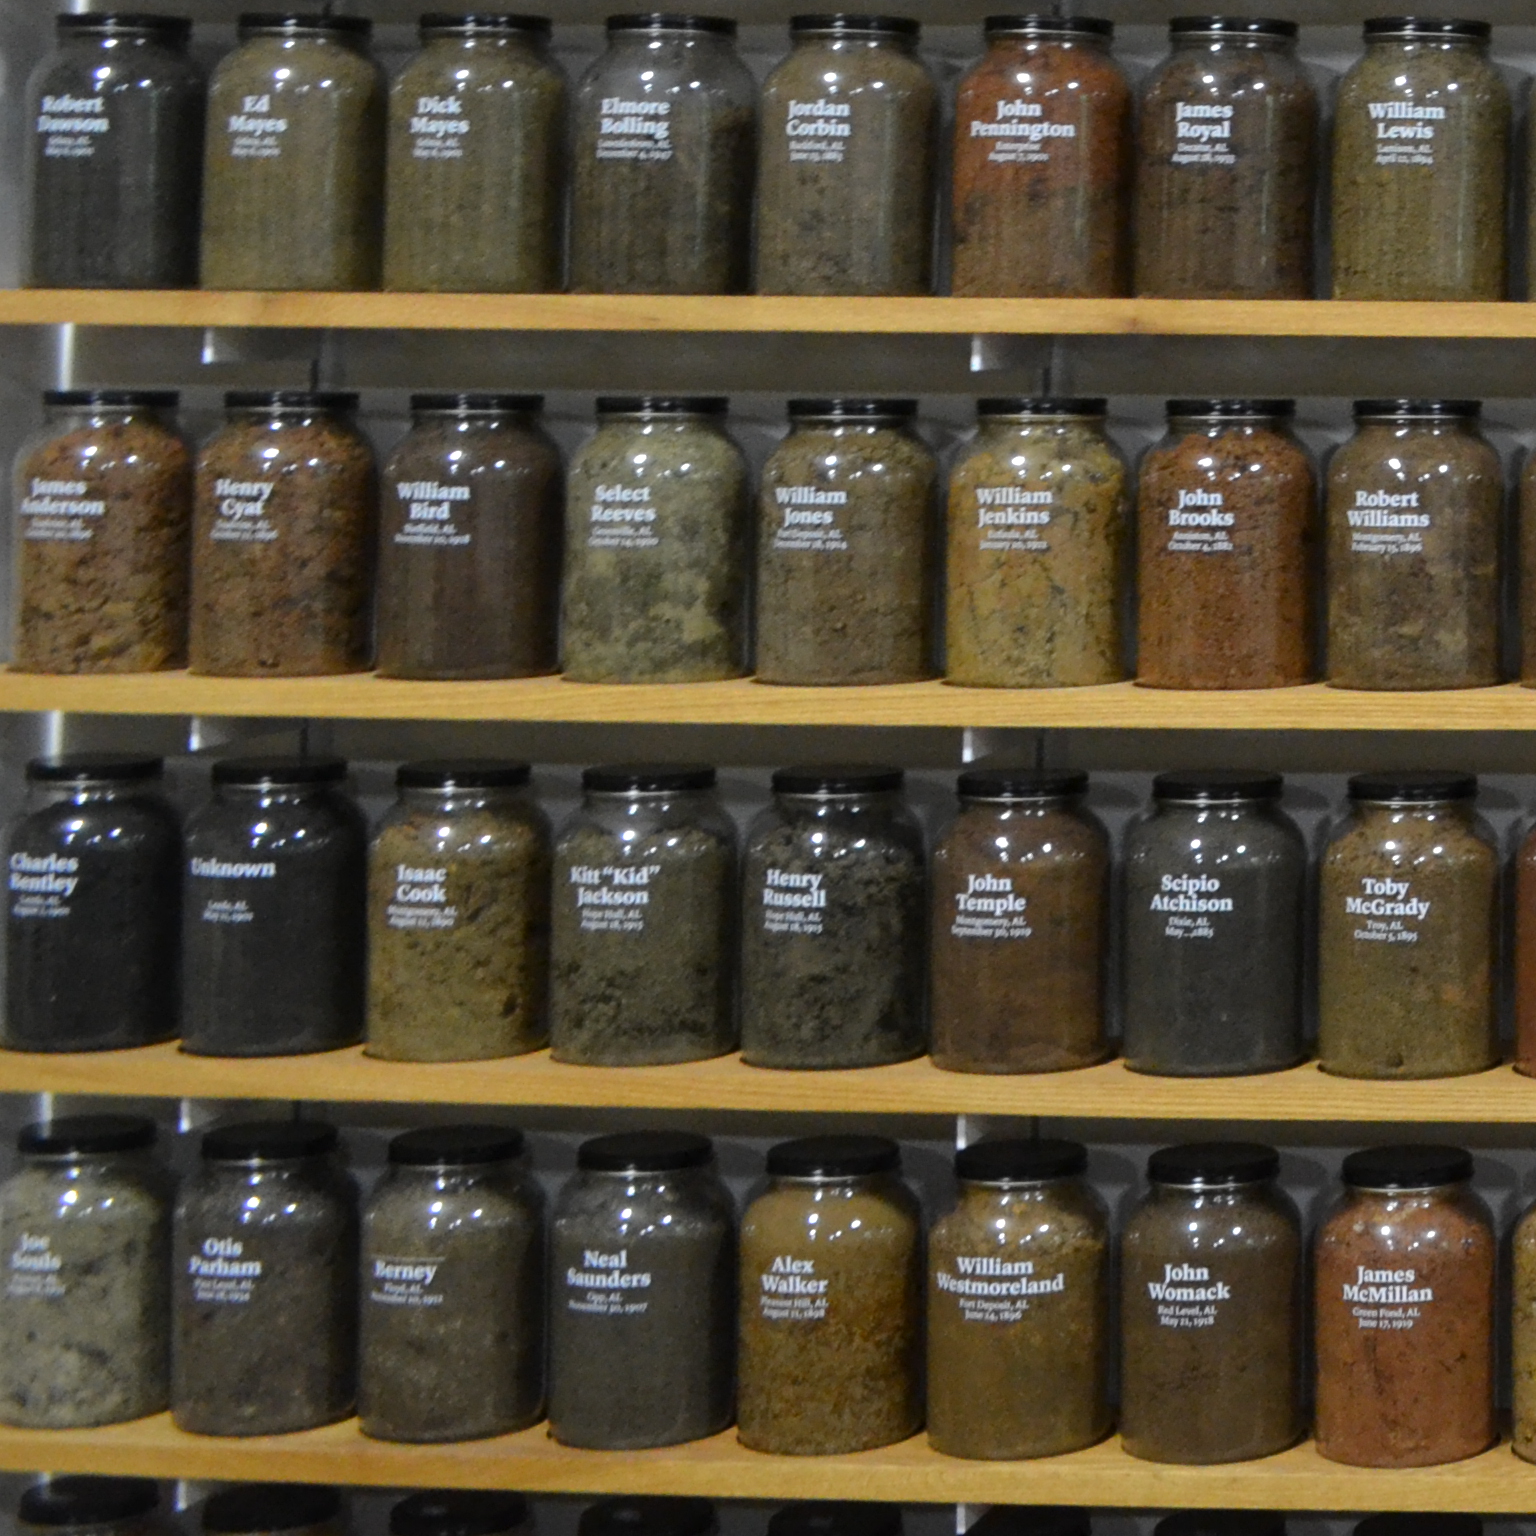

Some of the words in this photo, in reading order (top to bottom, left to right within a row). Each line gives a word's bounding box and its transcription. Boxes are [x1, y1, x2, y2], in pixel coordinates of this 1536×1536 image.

[417, 96, 462, 113] Dick
[1175, 102, 1234, 119] James
[1367, 102, 1446, 119] William
[410, 115, 470, 135] Mayes
[1176, 121, 1231, 140] Royal
[1376, 121, 1435, 139] Lewis
[775, 487, 848, 505] William
[1177, 490, 1223, 509] John
[1355, 490, 1419, 507] Robert
[783, 507, 834, 526] Jones
[1168, 509, 1235, 527] Brooks
[1346, 509, 1430, 528] Williams
[397, 865, 447, 883] Isaac
[764, 869, 823, 890] Henry
[966, 874, 1012, 894] John
[1361, 878, 1410, 899] Toby
[396, 885, 447, 903] Cook
[763, 889, 827, 907] Russell
[955, 894, 1027, 914] Temple
[1345, 897, 1431, 920] McGrady
[203, 1237, 243, 1258] Otis
[189, 1258, 262, 1278] Parham
[771, 1257, 815, 1275] Alex
[956, 1257, 1034, 1275] William
[1164, 1264, 1209, 1283] John
[1356, 1266, 1415, 1284] James
[761, 1276, 829, 1295] Walker
[937, 1275, 1065, 1295] Westmoreland
[1147, 1283, 1231, 1302] Womack
[1342, 1285, 1433, 1303] McMillan
